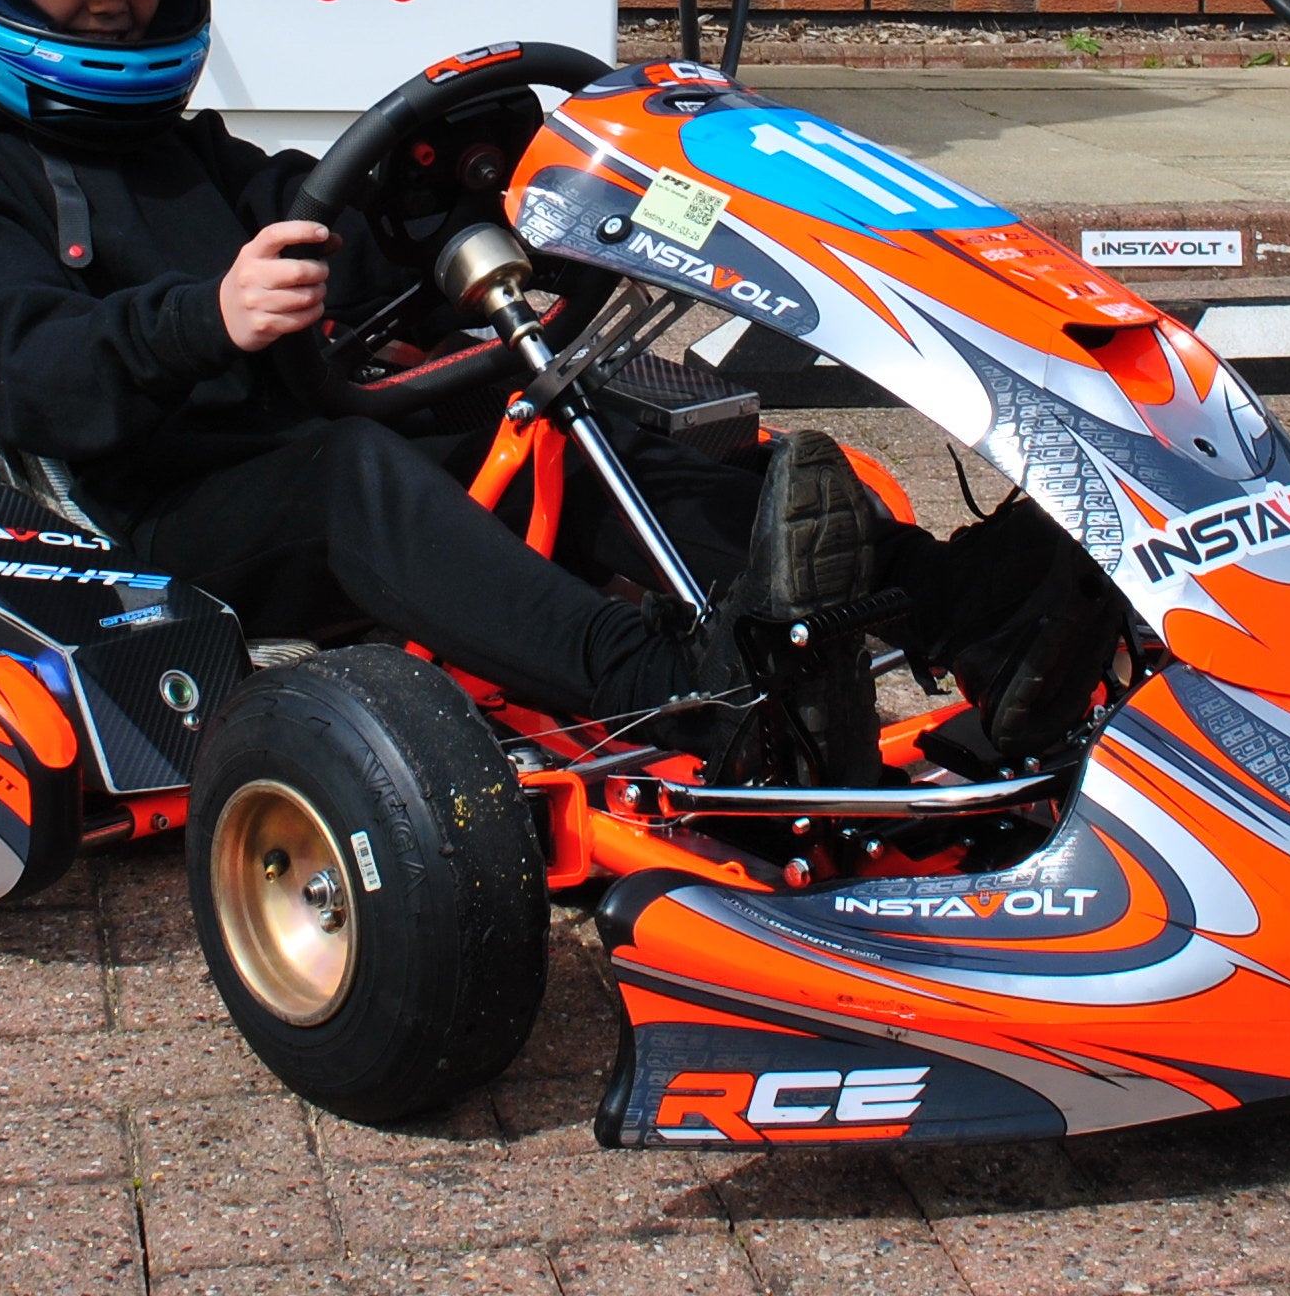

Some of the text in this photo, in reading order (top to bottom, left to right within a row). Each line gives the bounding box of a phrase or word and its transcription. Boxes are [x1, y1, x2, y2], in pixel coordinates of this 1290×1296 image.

[642, 208, 666, 226] Testing
[1101, 241, 1222, 256] INSTAVOLT
[628, 231, 800, 318] INSTAVOLT
[834, 888, 1099, 919] INSTAVOLT
[656, 1066, 931, 1141] RCE
